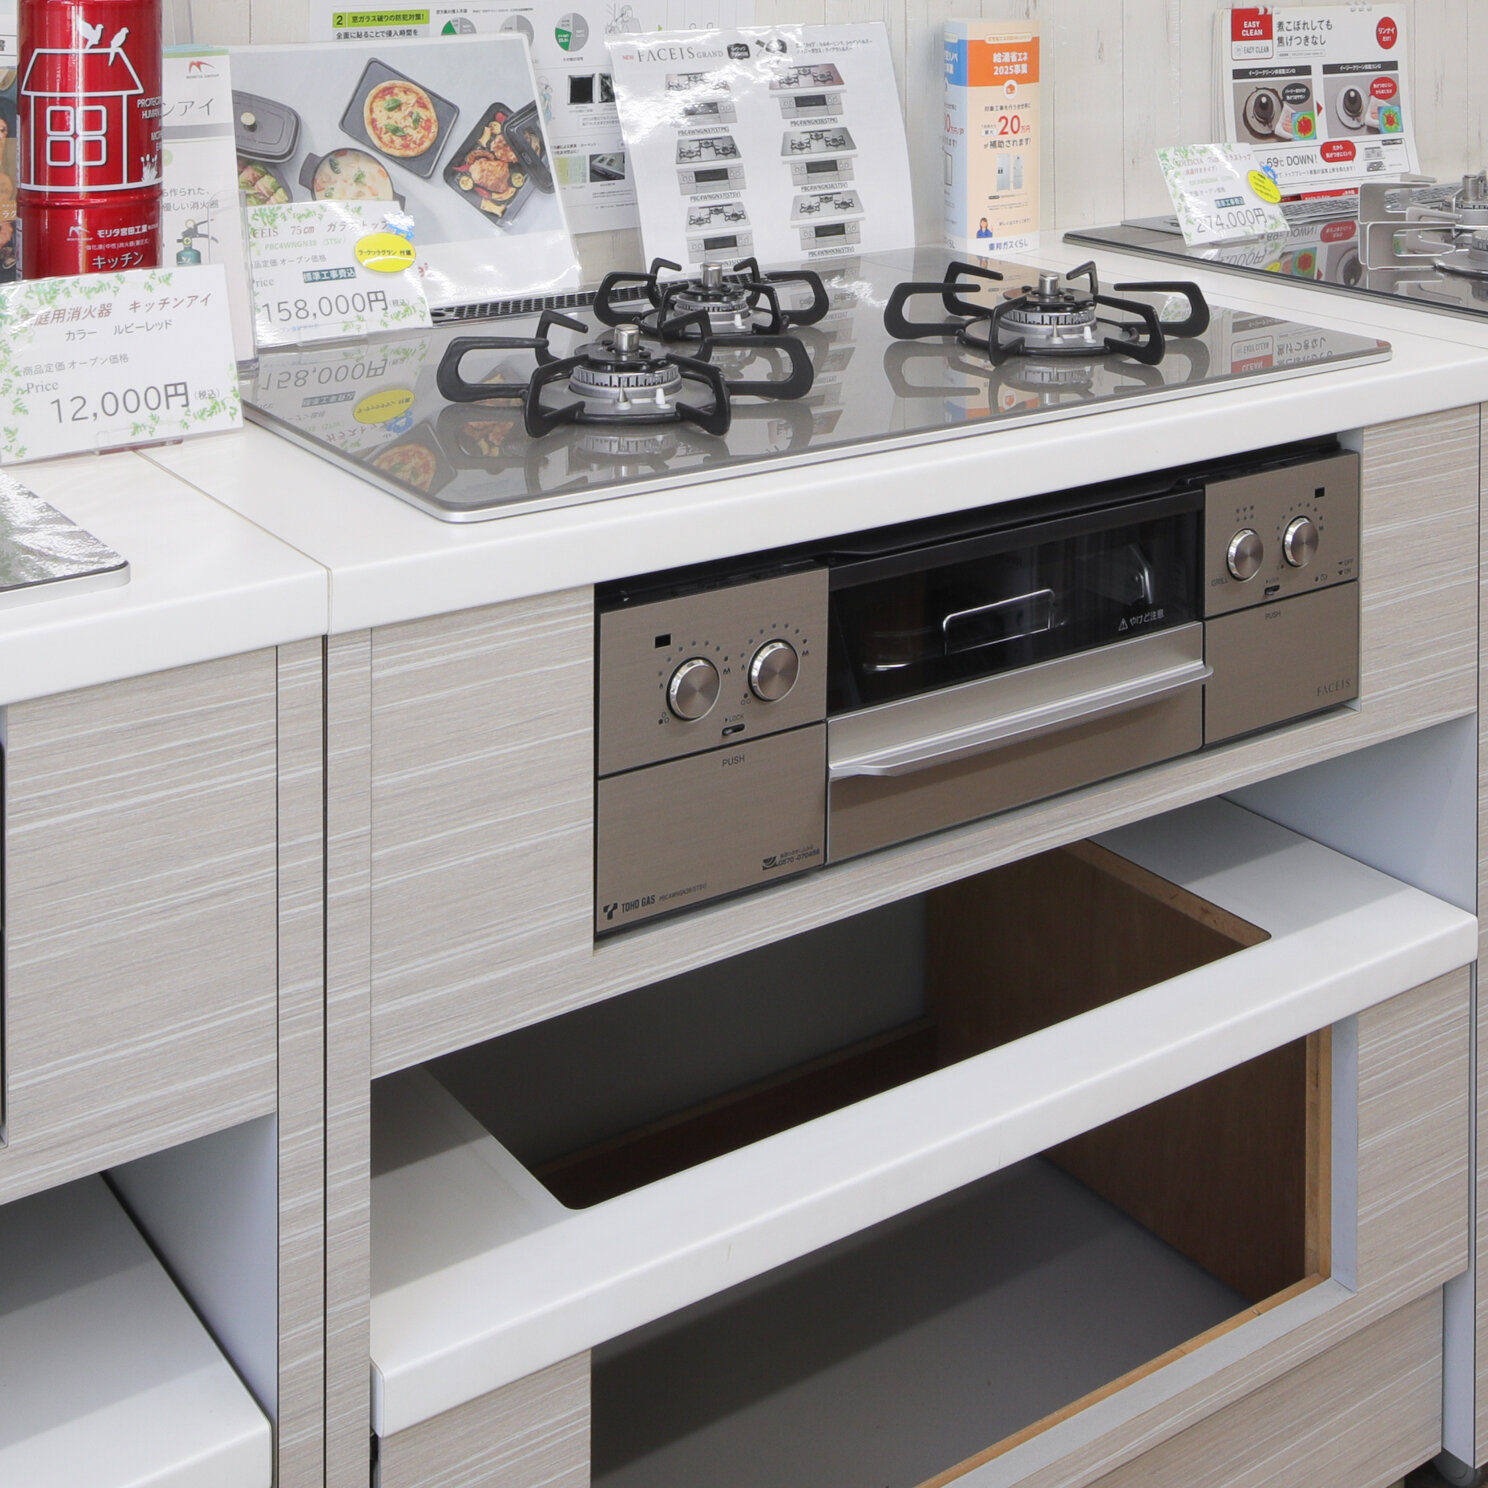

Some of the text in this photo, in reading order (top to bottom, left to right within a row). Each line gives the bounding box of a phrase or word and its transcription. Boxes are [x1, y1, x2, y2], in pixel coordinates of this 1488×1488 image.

[336, 15, 343, 25] 2
[1244, 20, 1260, 29] EASY
[1277, 19, 1333, 32] 煮こぼれしても
[336, 29, 419, 40] 全面に貼ることで侵入時間を
[1242, 29, 1263, 37] CLEAN
[1378, 27, 1395, 35] リンナイ
[1277, 34, 1326, 48] 焦げつきなし
[637, 47, 695, 62] FACEIS
[697, 50, 723, 58] GRAND
[993, 52, 1028, 62] 給湯省エネ
[1244, 46, 1269, 54] EASY CLEAN
[994, 63, 1028, 76] 2025事業
[998, 115, 1020, 135] 20
[1196, 208, 1267, 233] 274,000円
[988, 239, 1028, 251] 東邦ガスくらし
[92, 251, 143, 269] キッチン
[280, 255, 327, 266] オープン価格
[303, 267, 356, 283] 標準工事費込
[129, 292, 212, 313] キッチンアイ
[263, 291, 388, 323] 158,000円
[65, 319, 173, 342] カラー ルビーレッド
[22, 353, 129, 376] 商品定価 オープン価格
[25, 380, 59, 394] Price
[50, 381, 189, 424] 12,000円
[1130, 609, 1164, 626] やけど注意
[1265, 611, 1281, 620] PUSH
[1317, 679, 1351, 696] FACEIS
[729, 714, 744, 722] LOCK
[722, 755, 745, 767] PUSH
[622, 895, 655, 913] TOHO GAS
